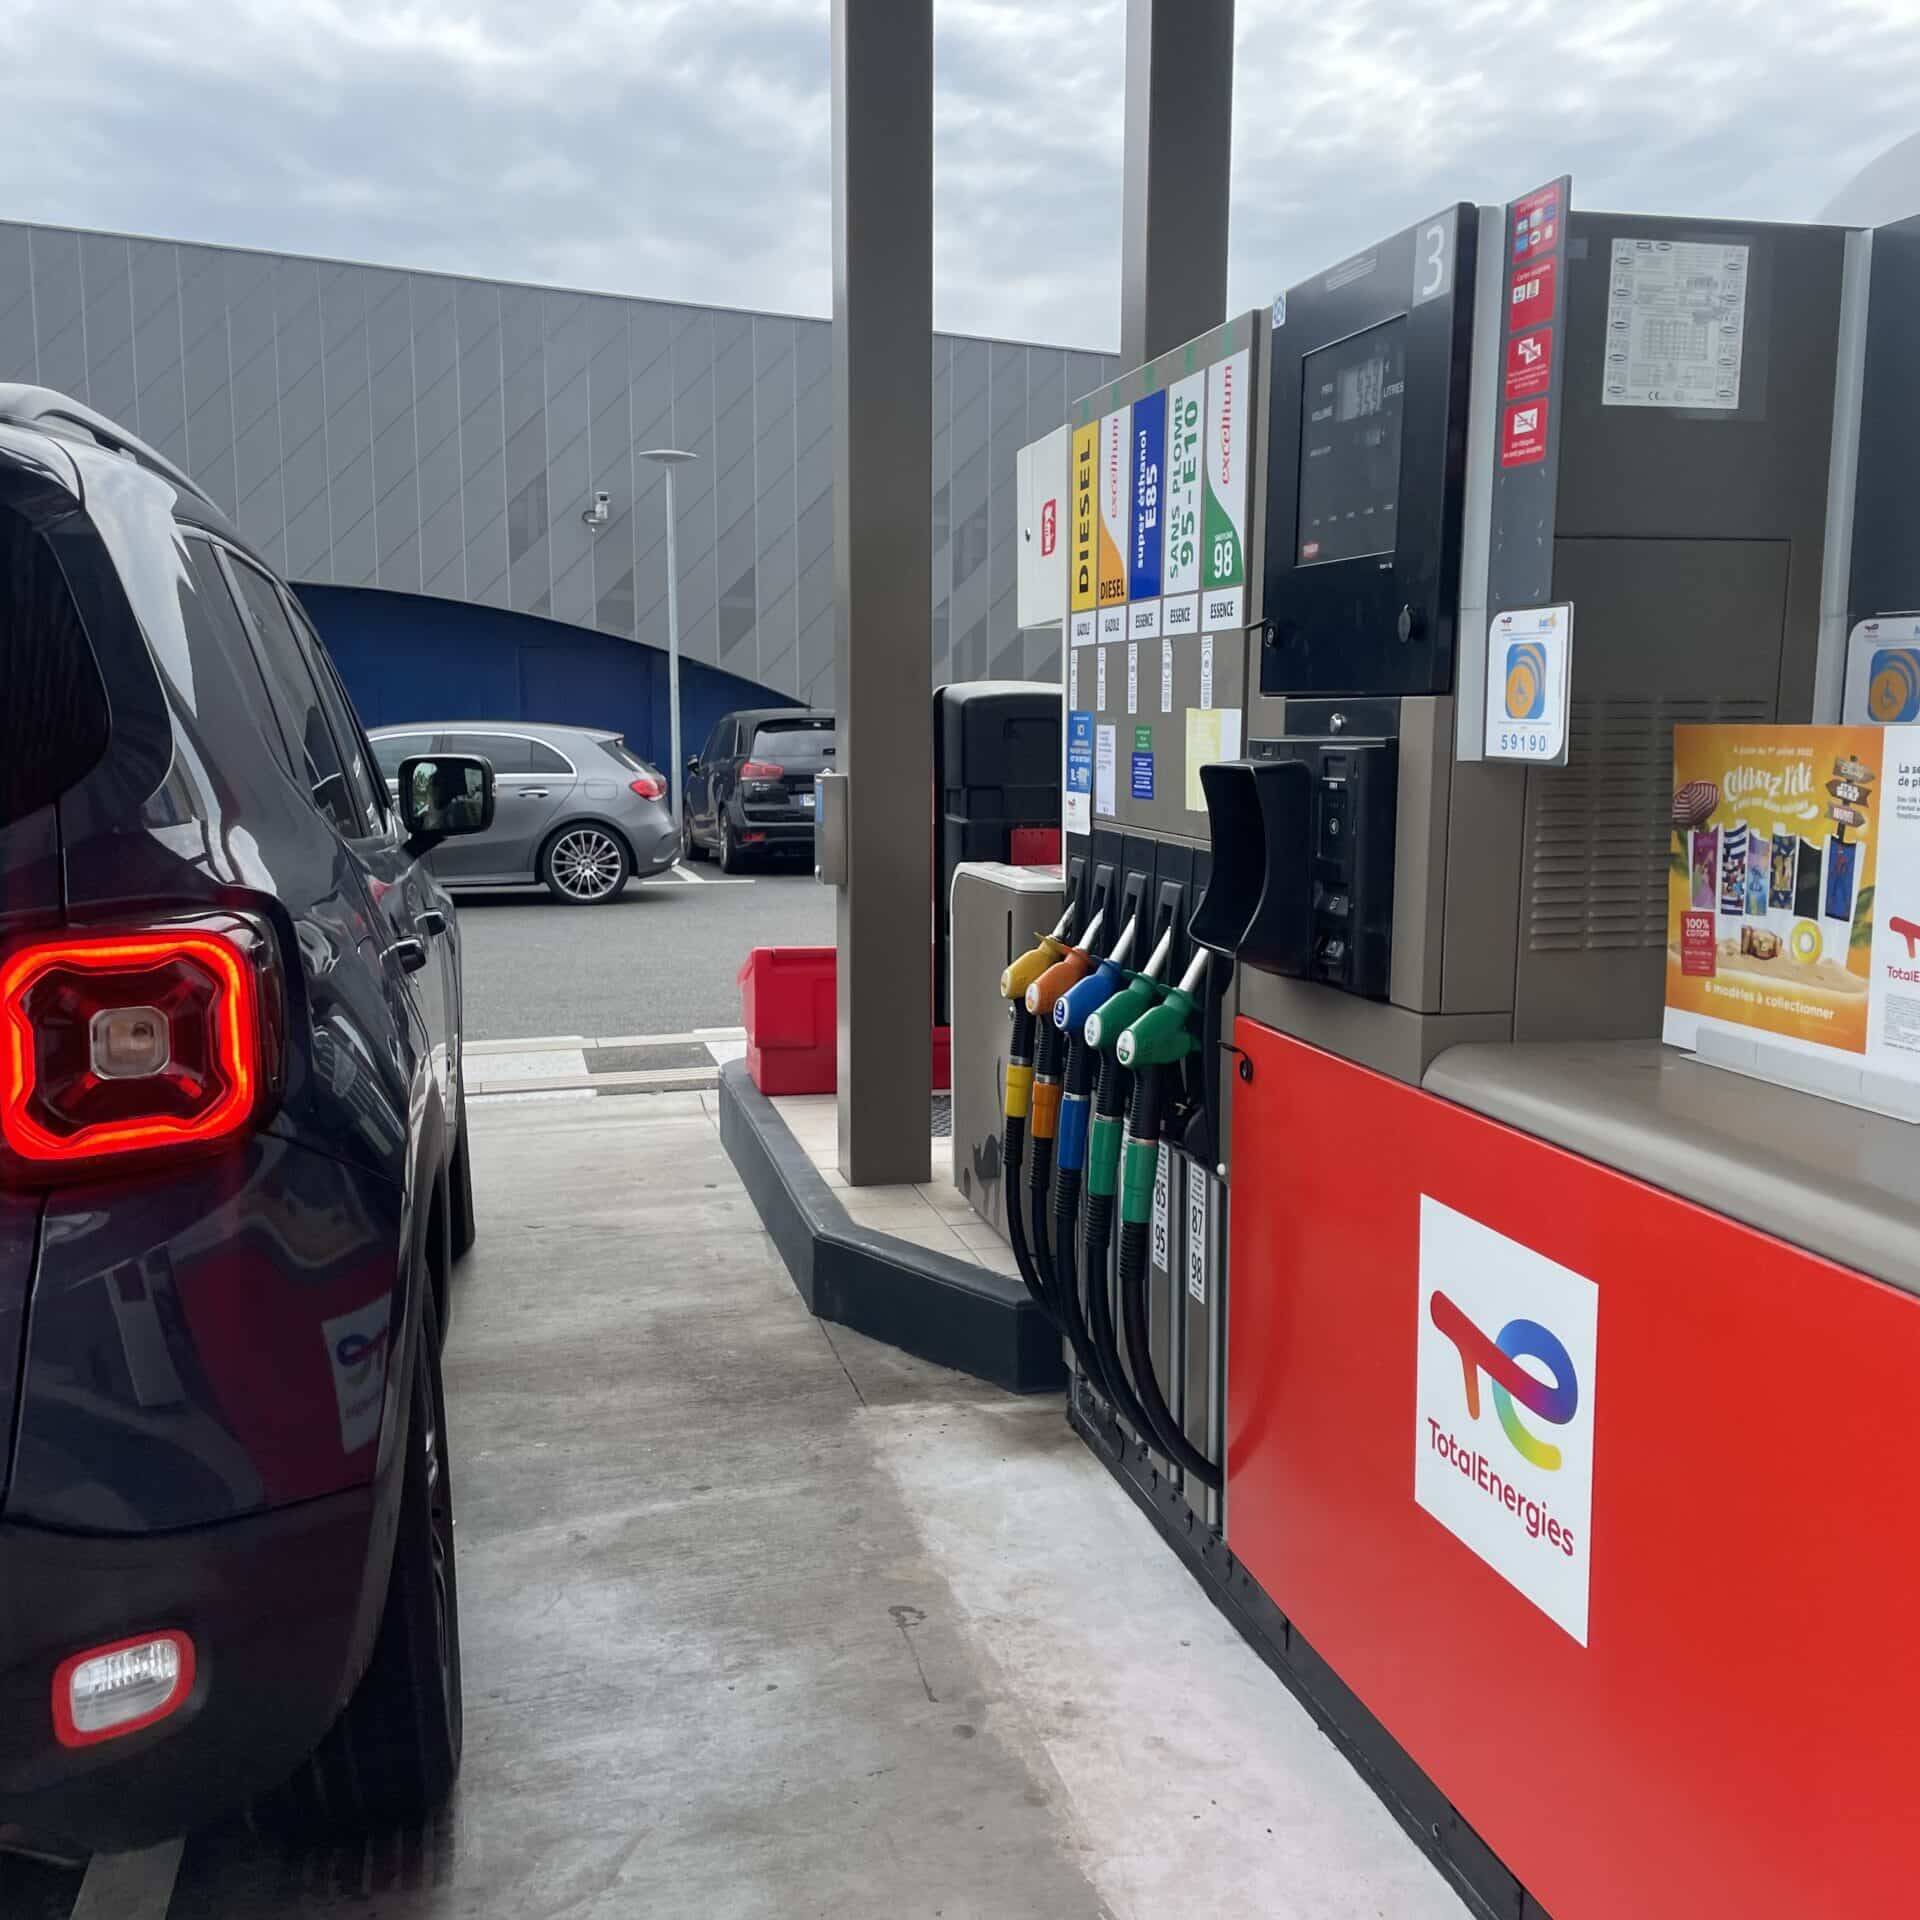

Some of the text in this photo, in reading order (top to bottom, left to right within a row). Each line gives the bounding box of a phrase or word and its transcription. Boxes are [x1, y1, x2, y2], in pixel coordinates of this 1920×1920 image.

[1422, 224, 1444, 297] 3
[1383, 381, 1405, 397] LITRES
[1221, 365, 1232, 485] excellium
[1145, 463, 1158, 529] E85
[1170, 395, 1183, 578] SANS PLOMB
[1079, 439, 1091, 593] DIESEL
[1137, 515, 1146, 569] super
[1213, 540, 1233, 579] 98
[1100, 578, 1125, 601] DIESEL
[1135, 613, 1153, 629] ESSENCE
[1170, 607, 1190, 624] ESSENCE
[1210, 600, 1234, 619] ESSENCE
[1500, 733, 1547, 752] 59190
[1898, 762, 1910, 774] La
[1898, 777, 1910, 787] de
[1685, 918, 1710, 929] 100%
[1686, 929, 1710, 938] COTON
[1704, 981, 1711, 993] 6
[1713, 983, 1754, 1003] modèles
[1766, 995, 1836, 1020] collectionner
[1191, 1206, 1203, 1236] 87
[1191, 1253, 1203, 1285] 98
[1427, 1416, 1575, 1557] TotalEnergies
